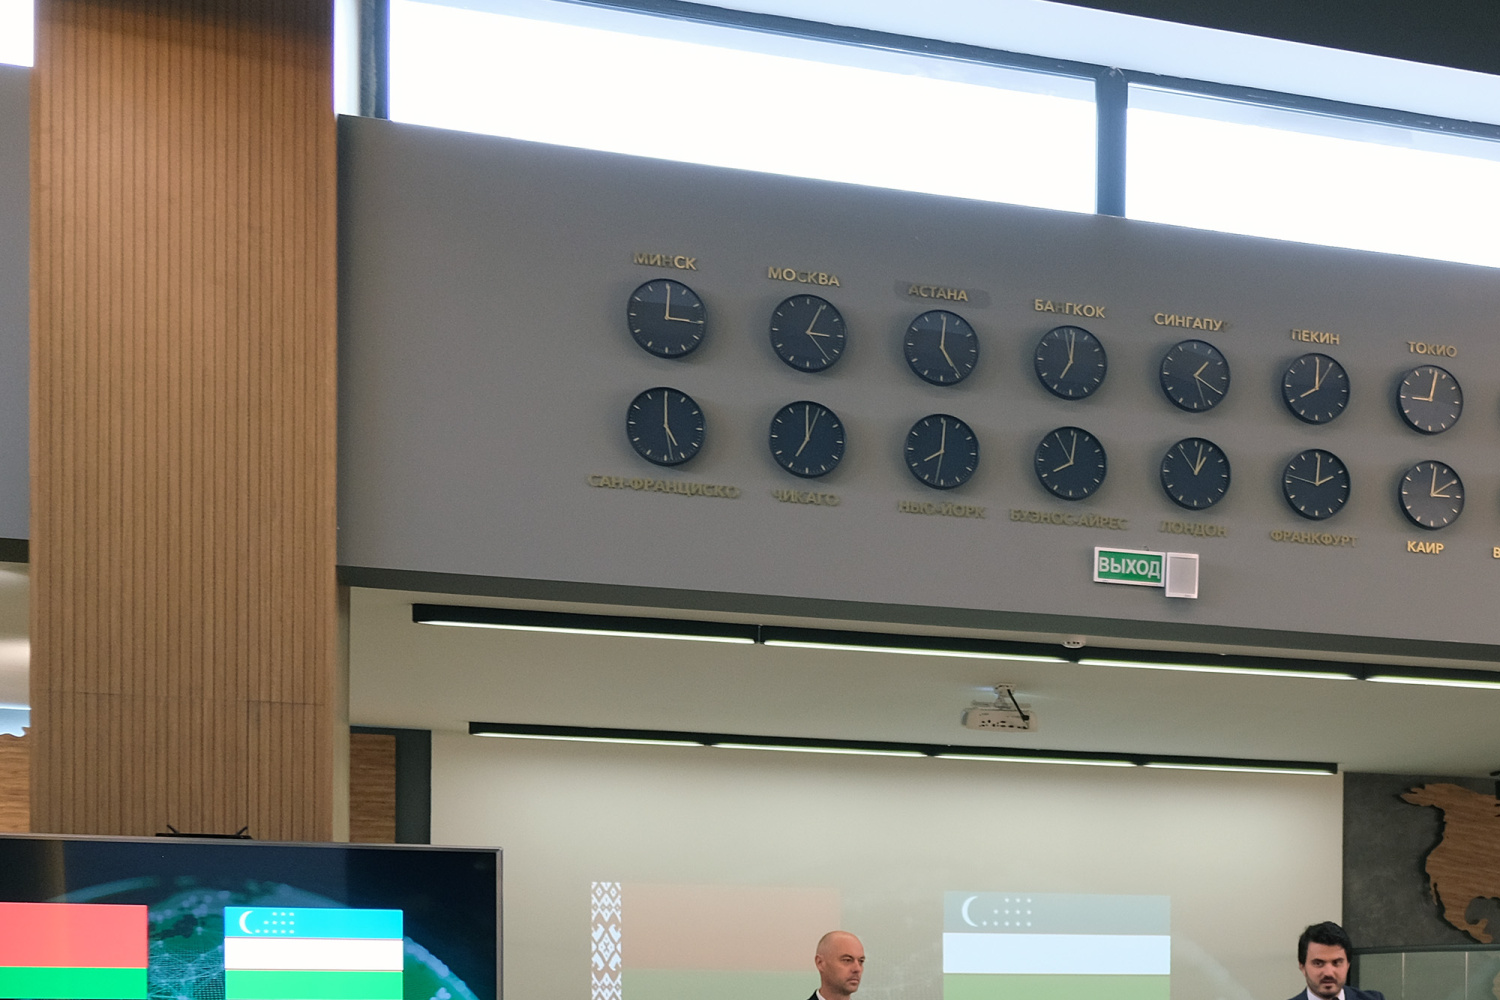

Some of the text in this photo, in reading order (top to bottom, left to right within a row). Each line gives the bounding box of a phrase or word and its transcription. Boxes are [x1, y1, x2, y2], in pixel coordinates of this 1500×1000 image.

[633, 252, 697, 270] МИНСК
[768, 266, 840, 287] МОСКВА
[908, 284, 968, 301] АСТАНА
[1034, 299, 1105, 318] БАНГКОК
[1291, 328, 1340, 345] ПЕКИН
[1407, 341, 1457, 357] ТОКИО
[587, 474, 740, 498] САН-ФРАНЦИСКО
[772, 488, 841, 507] ЧИКАГО
[899, 500, 987, 519] НЬЮ-ЙОРК
[1010, 508, 1128, 531] БУЭНОС-АЙРЕС
[1161, 520, 1228, 538] ЛОНДОН
[1270, 530, 1358, 547] ФРАНКФУРТ
[1407, 540, 1444, 555] КАИР
[1098, 556, 1161, 579] ВЫХОД
